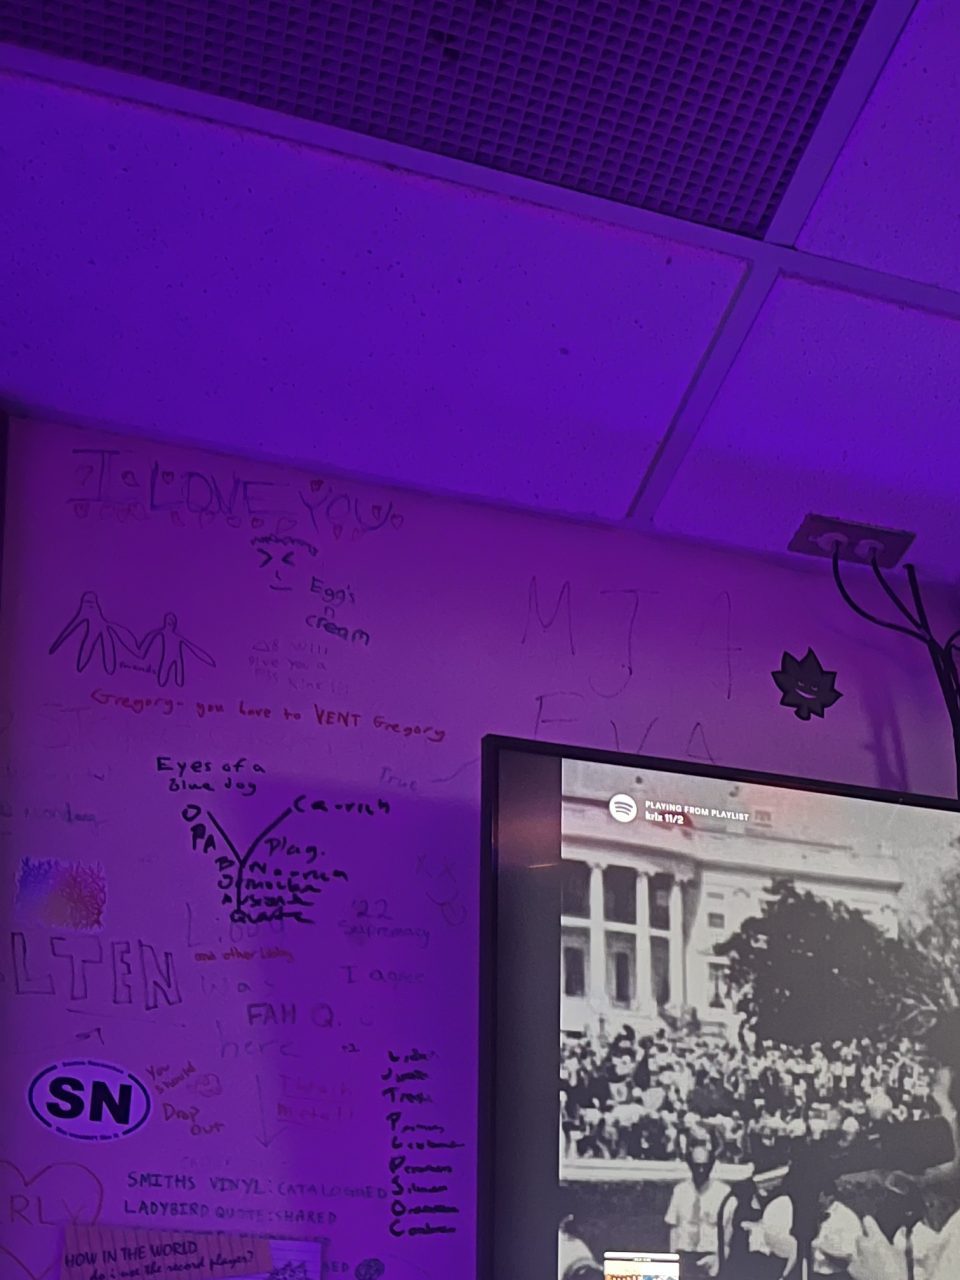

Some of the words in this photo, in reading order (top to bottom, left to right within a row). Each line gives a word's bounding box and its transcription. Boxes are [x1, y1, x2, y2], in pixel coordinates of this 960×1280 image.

[67, 449, 120, 503] I
[150, 460, 292, 516] LOVE
[196, 704, 225, 720] you
[239, 700, 271, 720] have
[284, 708, 301, 720] to
[314, 703, 362, 728] VENT
[373, 716, 445, 742] Gregory
[156, 756, 212, 776] Eyes
[222, 757, 248, 773] of
[253, 762, 267, 774] a
[224, 777, 257, 796] dog
[645, 800, 682, 813] PLAYING
[684, 805, 709, 816] FROM
[711, 809, 750, 822] PLAYLIST
[664, 813, 685, 825] 11/2
[46, 1076, 133, 1125] SN
[127, 1171, 197, 1191] SMITHS
[124, 1200, 210, 1218] LADYBIRD
[65, 1252, 97, 1267] HOW
[103, 1248, 118, 1263] IN
[121, 1245, 146, 1261] THE
[150, 1241, 198, 1259] WORLD
[167, 1256, 205, 1272] record
[209, 1250, 254, 1272] player?
